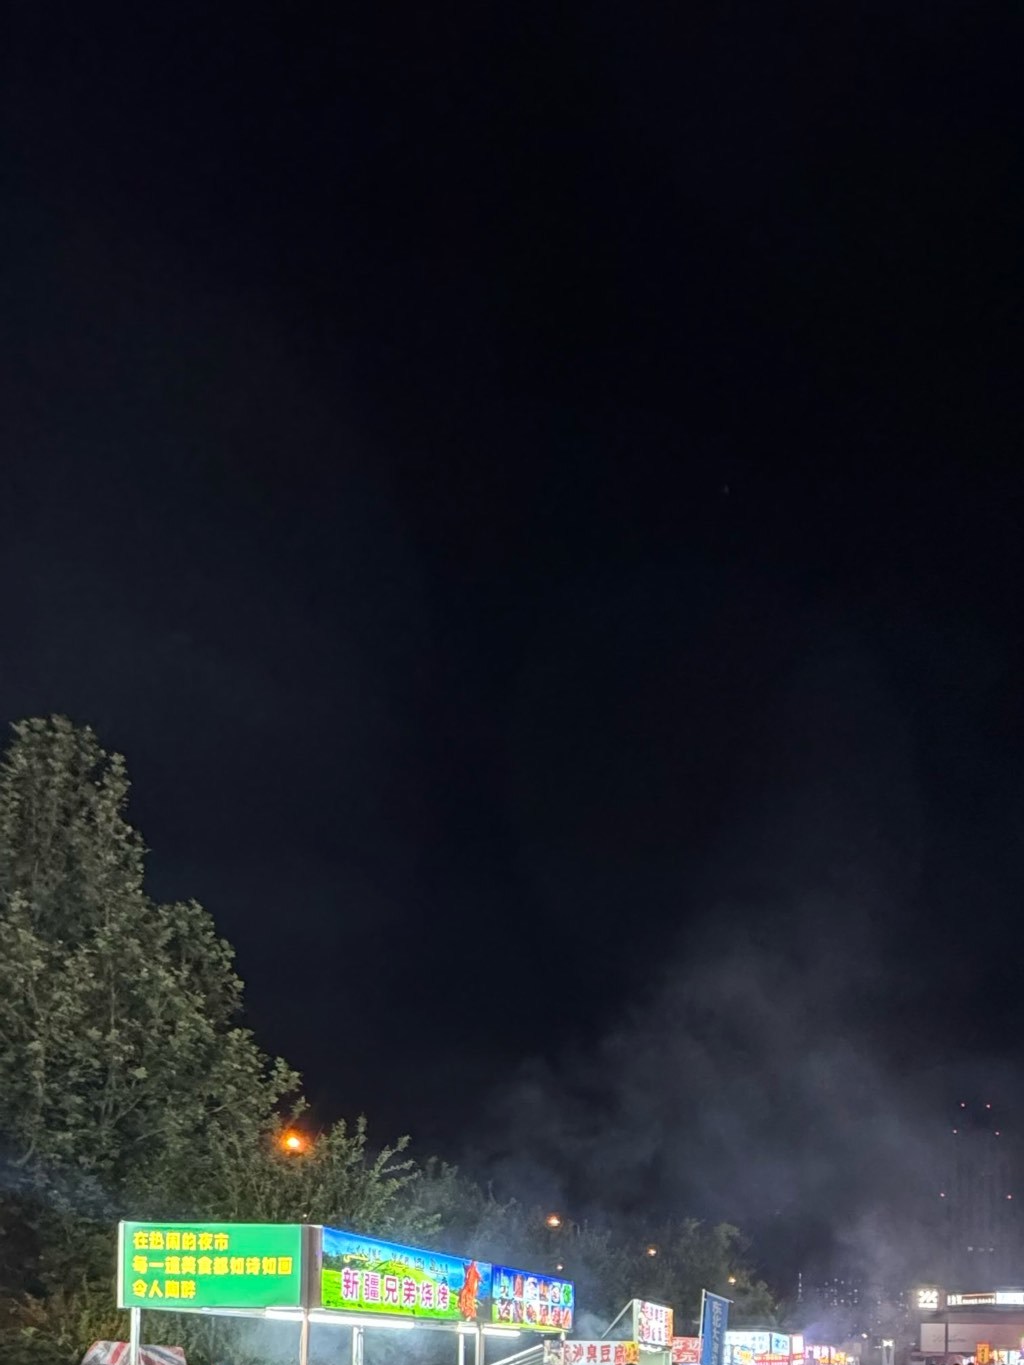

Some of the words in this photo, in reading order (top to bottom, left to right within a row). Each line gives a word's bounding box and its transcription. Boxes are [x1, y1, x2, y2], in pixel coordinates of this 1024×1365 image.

[341, 1267, 449, 1309] 新疆兄弟烧烤
